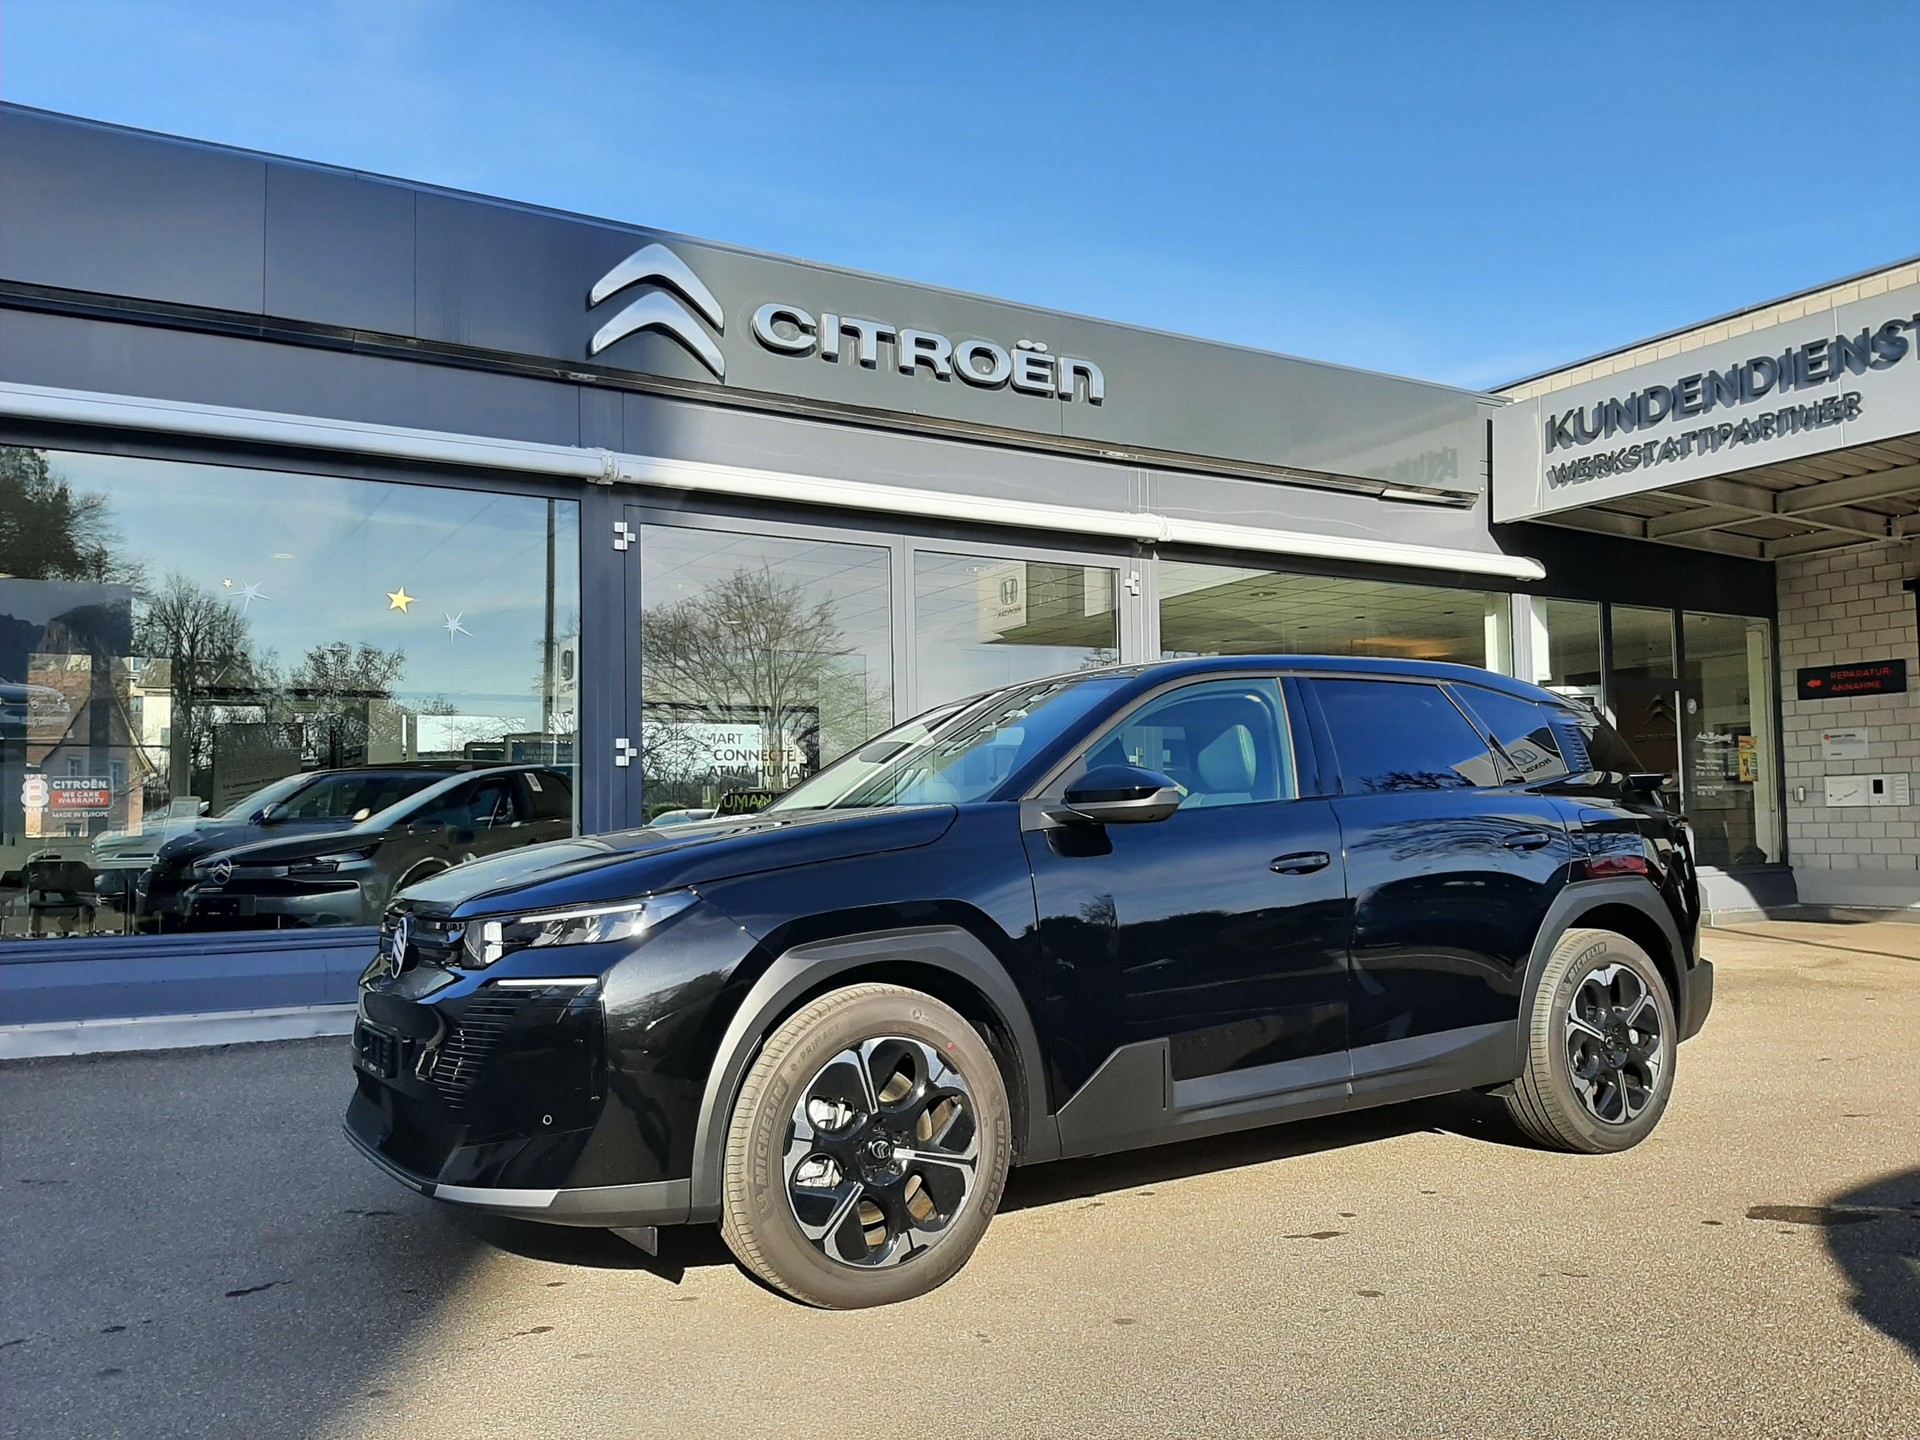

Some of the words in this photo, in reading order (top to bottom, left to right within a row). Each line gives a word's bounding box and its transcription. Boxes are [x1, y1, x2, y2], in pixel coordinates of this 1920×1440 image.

[752, 302, 1106, 406] CITROËN
[1546, 391, 1864, 489] WERKSTATTPARTNER
[1831, 680, 1883, 691] ANNAHME
[52, 778, 107, 790] CITROËN
[1567, 943, 1607, 984] MICHELIN
[756, 1080, 788, 1187] MICHELIN
